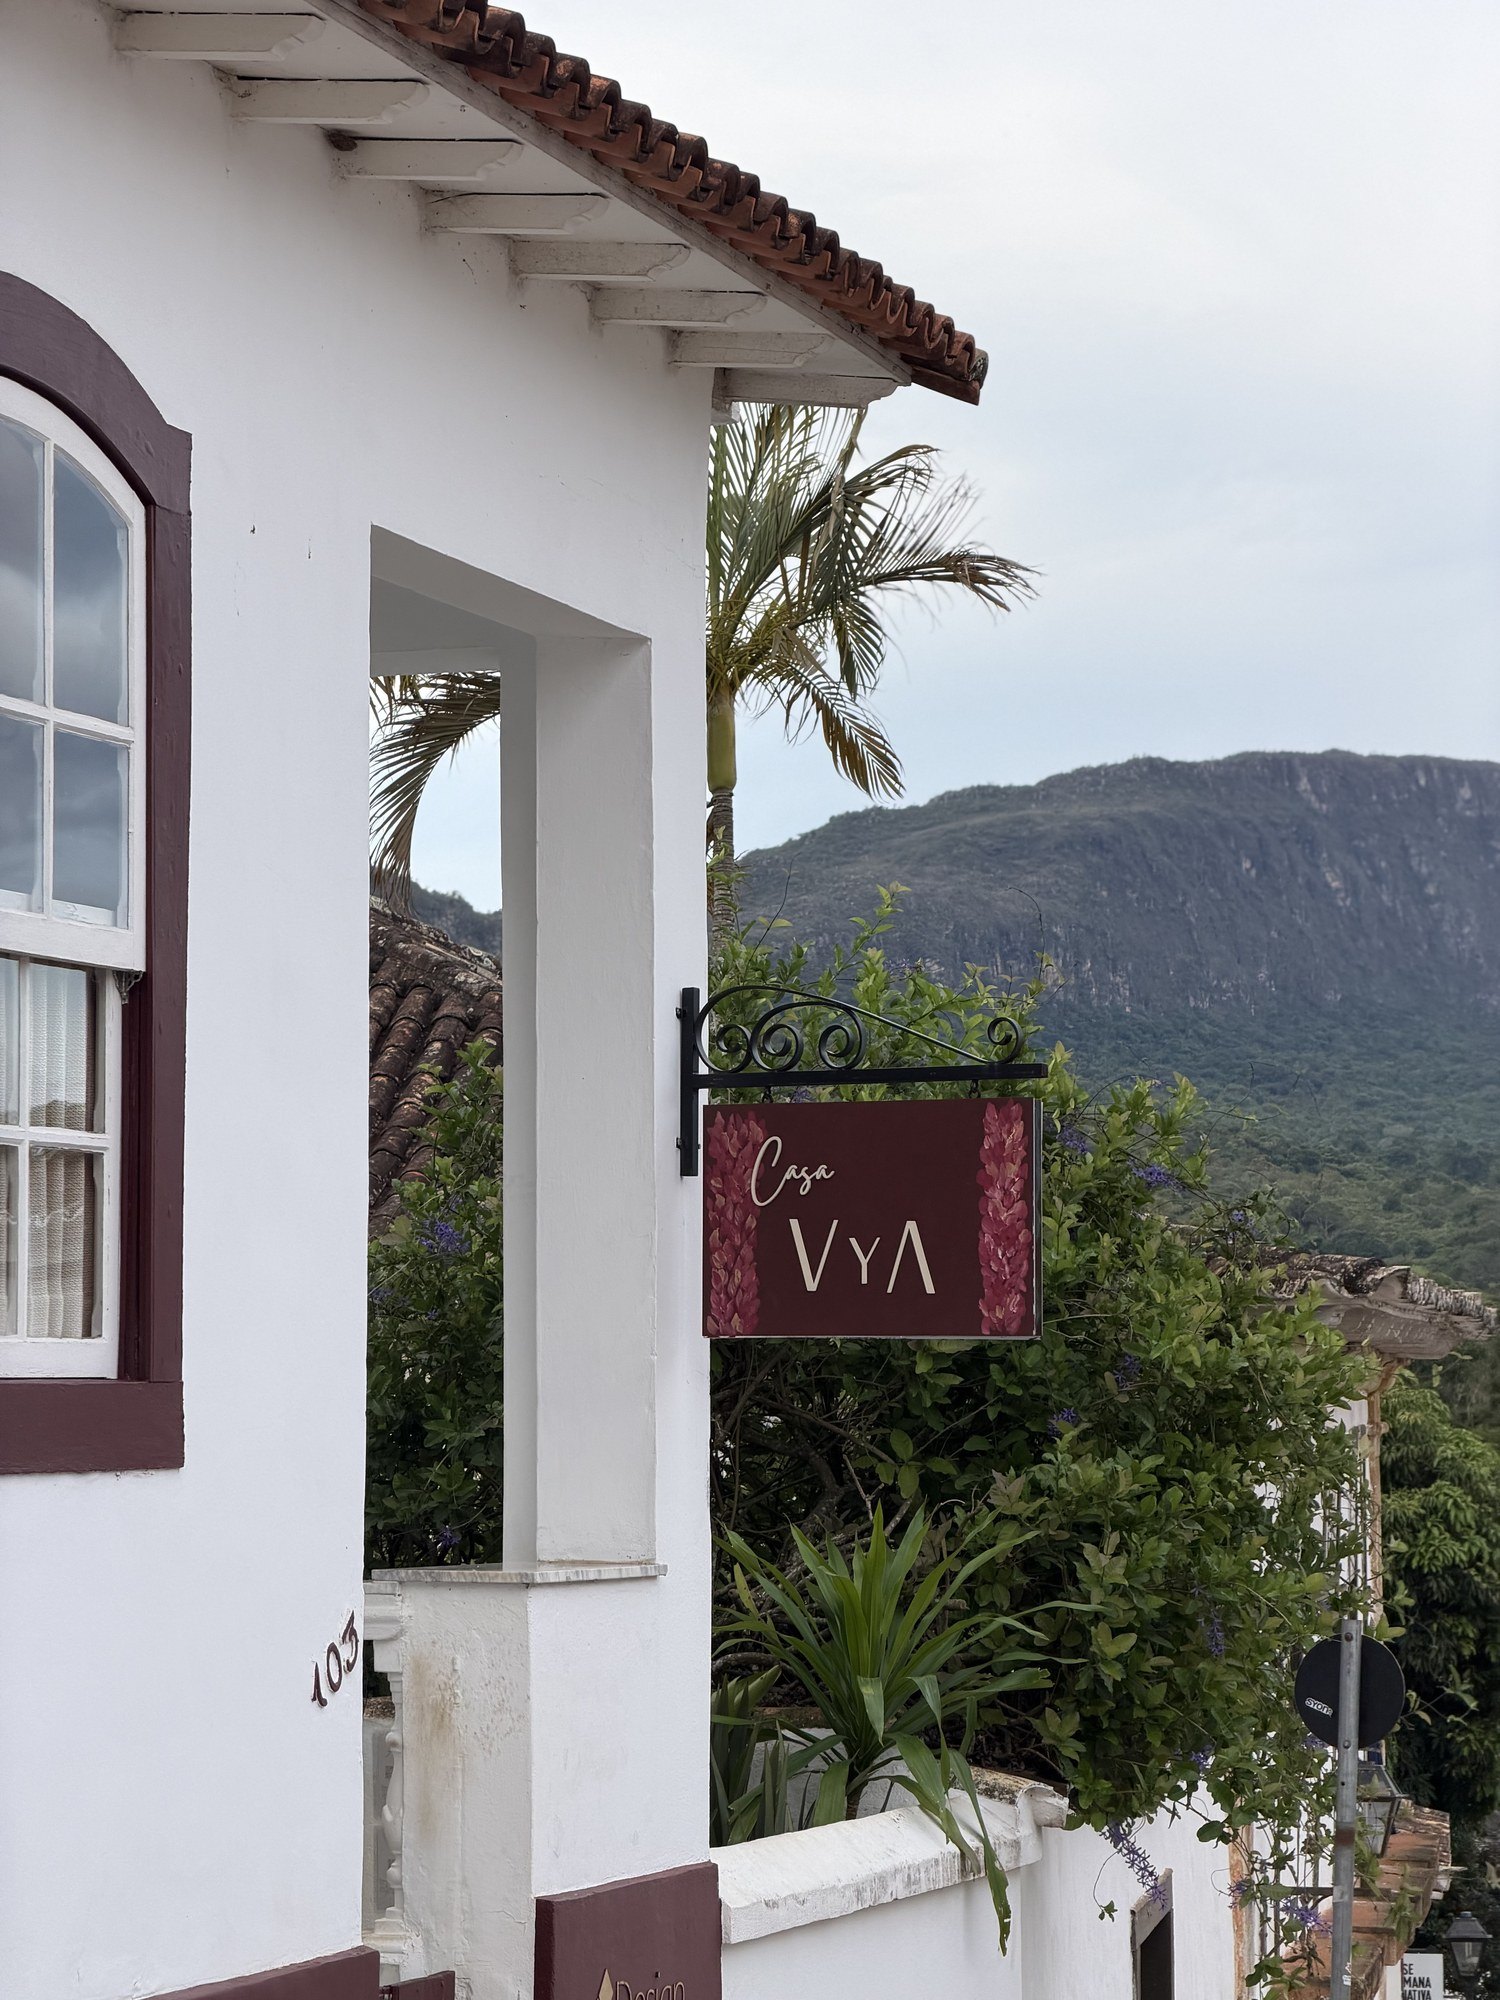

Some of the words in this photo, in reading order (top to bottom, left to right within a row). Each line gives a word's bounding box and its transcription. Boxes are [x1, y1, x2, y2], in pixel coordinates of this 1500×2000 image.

[750, 1135, 835, 1207] Casa
[311, 1609, 360, 1707] 103
[1402, 1963, 1414, 1975] SE
[1403, 1976, 1432, 1989] MANA
